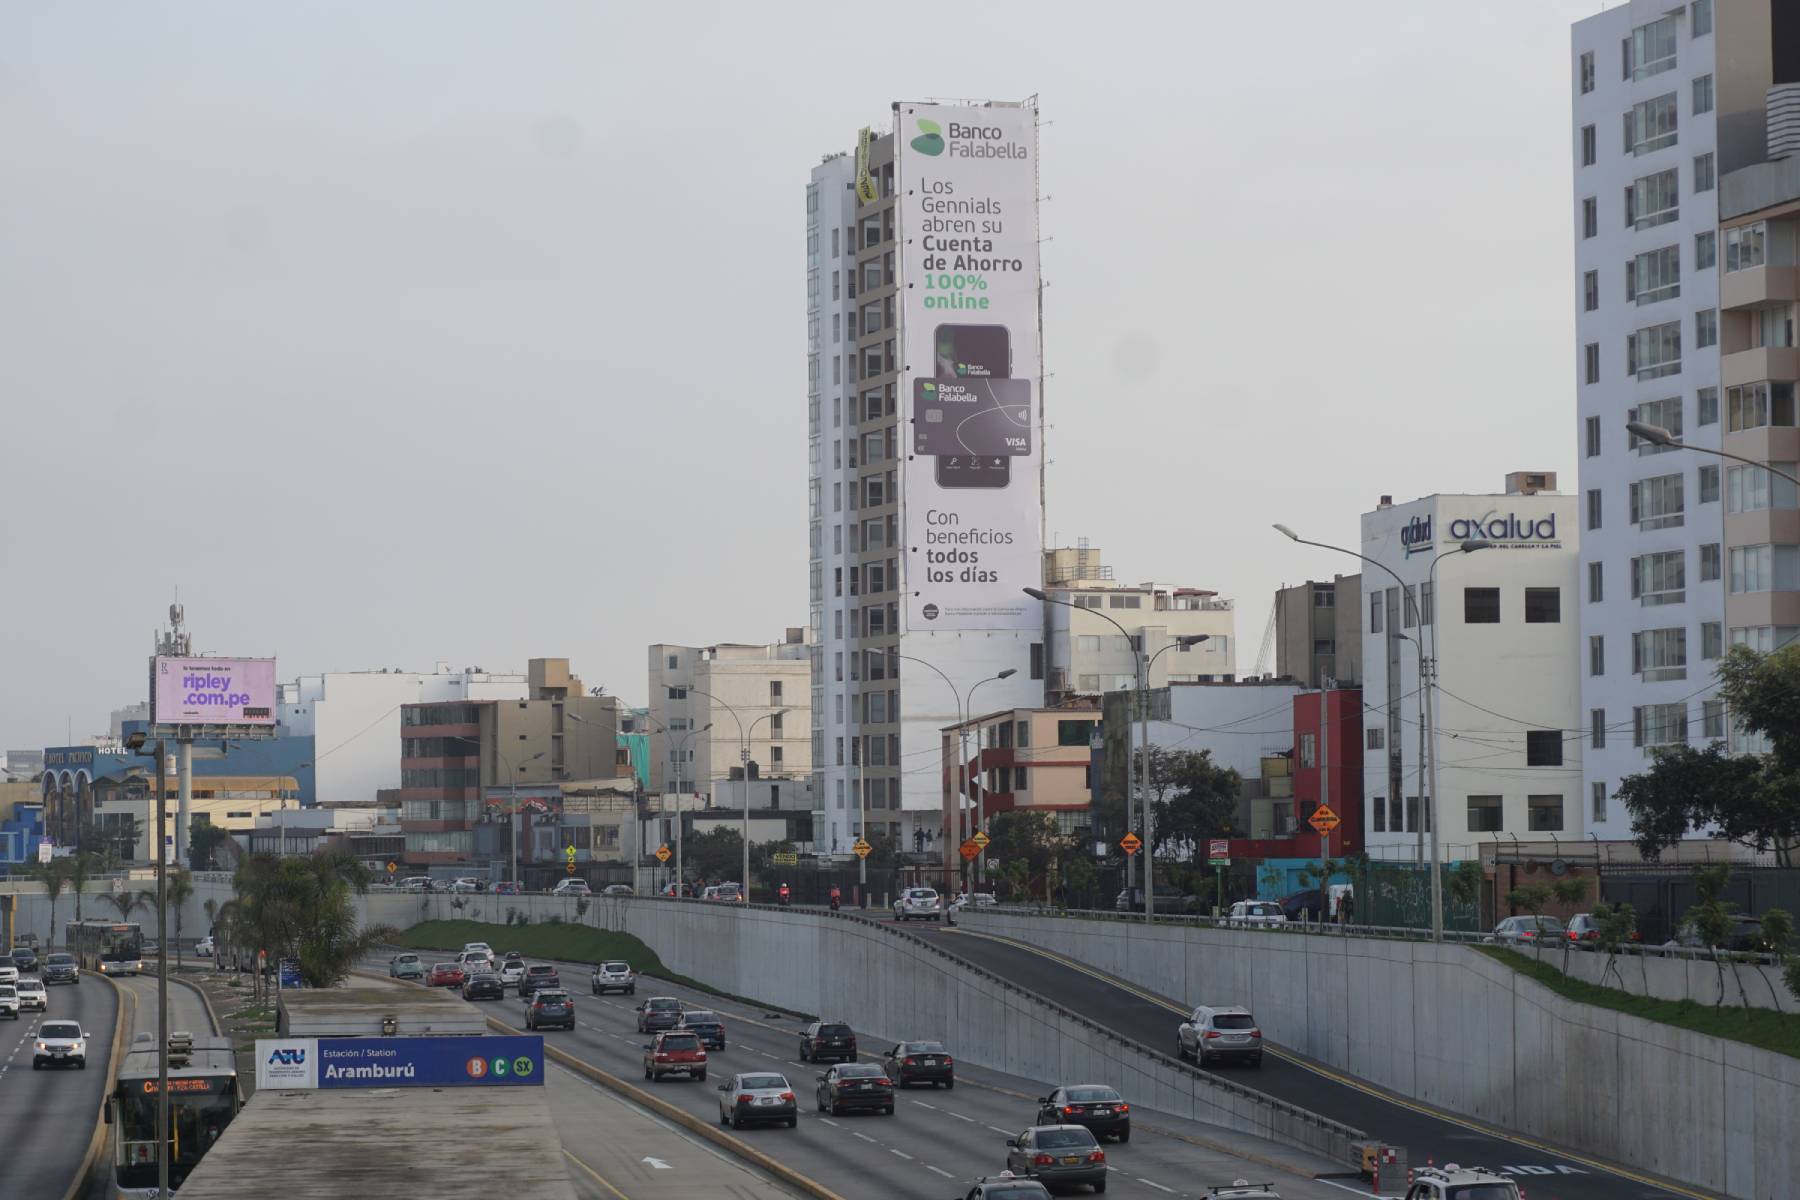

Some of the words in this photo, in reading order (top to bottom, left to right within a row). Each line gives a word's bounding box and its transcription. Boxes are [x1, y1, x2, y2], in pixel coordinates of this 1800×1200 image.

[949, 123, 1002, 139] Banco
[949, 141, 1028, 159] Falabella
[921, 177, 954, 195] Los
[922, 198, 1001, 215] Gennials
[922, 216, 975, 233] abren
[982, 220, 1002, 233] su
[923, 235, 993, 253] Cuenta
[923, 255, 947, 271] de
[954, 255, 1023, 272] Ahorro
[924, 274, 988, 290] 100%
[923, 293, 990, 310] online
[938, 384, 965, 393] Banco
[938, 393, 977, 402] Falabella
[1005, 438, 1026, 446] VISA
[926, 509, 959, 526] Con
[1450, 510, 1555, 541] axalud
[926, 528, 1013, 544] beneficios
[926, 547, 978, 564] todos
[927, 566, 954, 583] los
[960, 566, 998, 583] días
[183, 673, 231, 692] ripley
[183, 692, 250, 708] .com.pe
[98, 747, 128, 755] HOTEL
[268, 1048, 305, 1065] ATU
[323, 1049, 359, 1058] Estación
[366, 1049, 397, 1057] Station
[325, 1062, 415, 1079] Aramburú
[472, 1060, 482, 1074] B
[495, 1059, 505, 1075] C
[516, 1061, 530, 1072] SX
